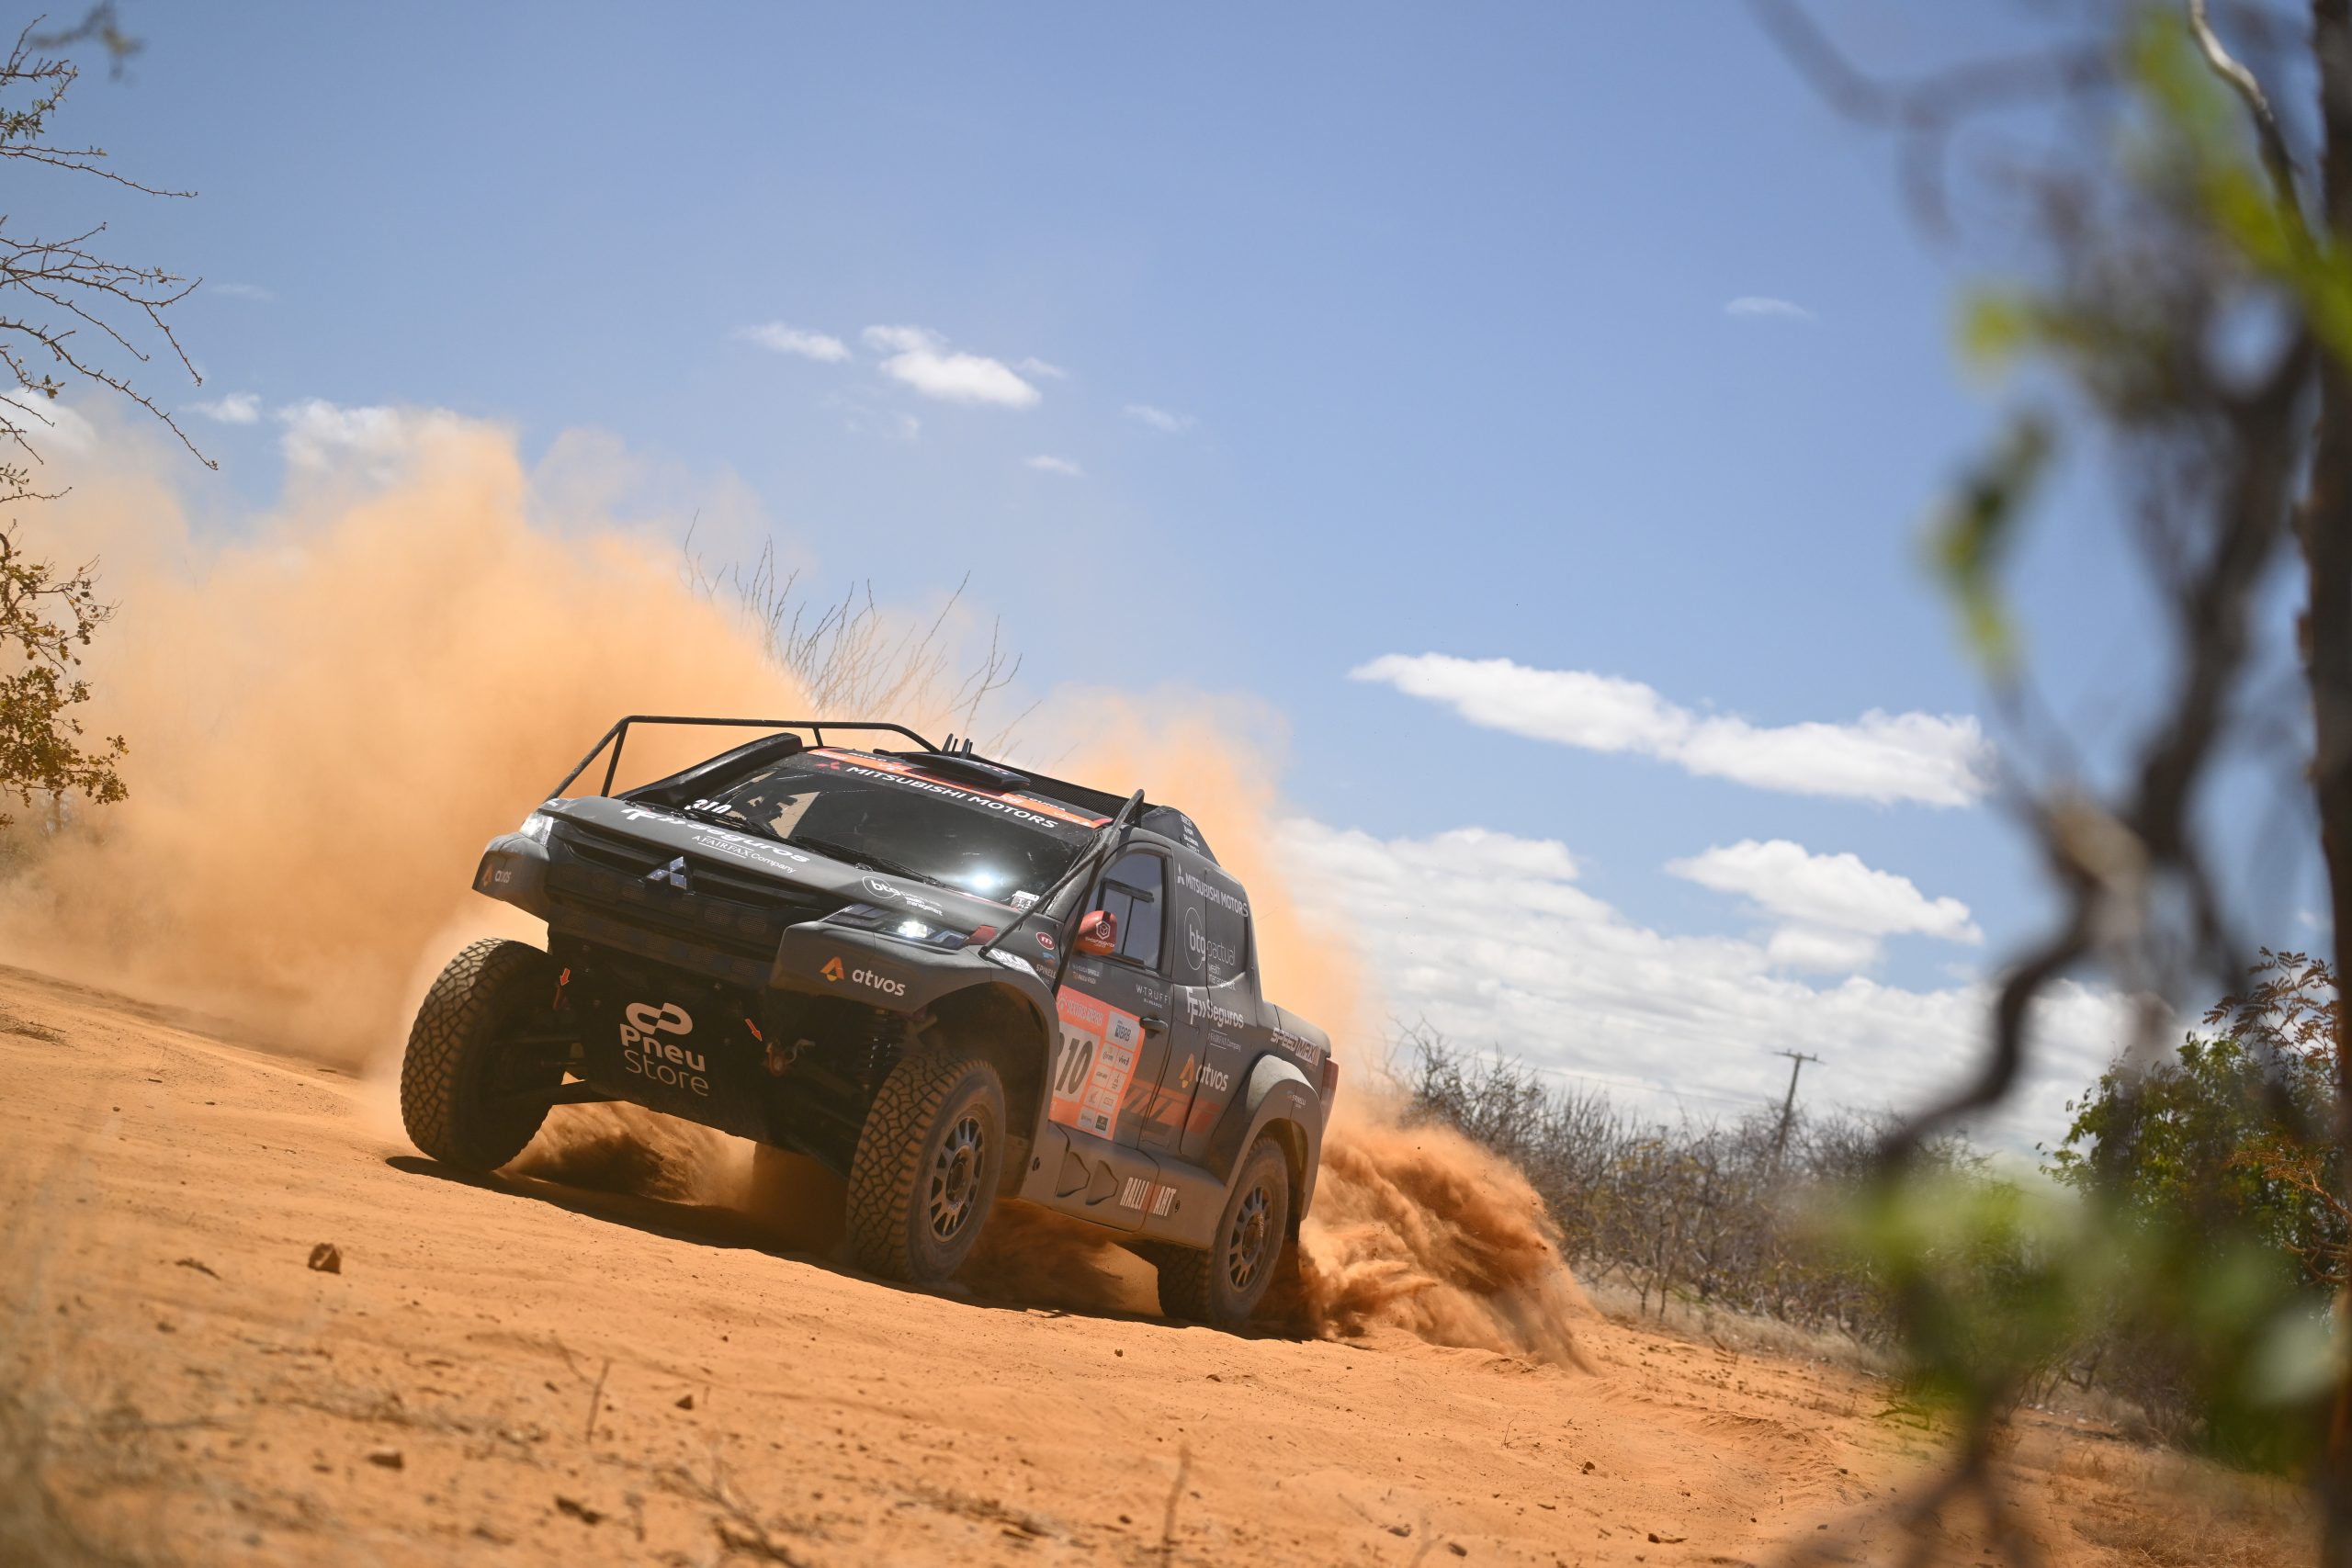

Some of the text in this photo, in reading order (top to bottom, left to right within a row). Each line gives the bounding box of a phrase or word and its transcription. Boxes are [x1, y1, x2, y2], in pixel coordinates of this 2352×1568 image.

[845, 766, 967, 798] MITSUBISHI
[967, 795, 1058, 829] MOTORS
[701, 837, 750, 857] FAIRFAX
[750, 852, 797, 874] Company
[870, 879, 901, 897] btg
[1185, 872, 1249, 918] MITSUBISHI MOTORS
[1189, 923, 1236, 966] btg pactual
[852, 968, 906, 997] atvos
[1035, 964, 1057, 979] SPINELL
[619, 1023, 706, 1072] Pneu
[1270, 1027, 1299, 1052] SPEED
[624, 1049, 709, 1097] Store
[1196, 1062, 1229, 1091] atvos
